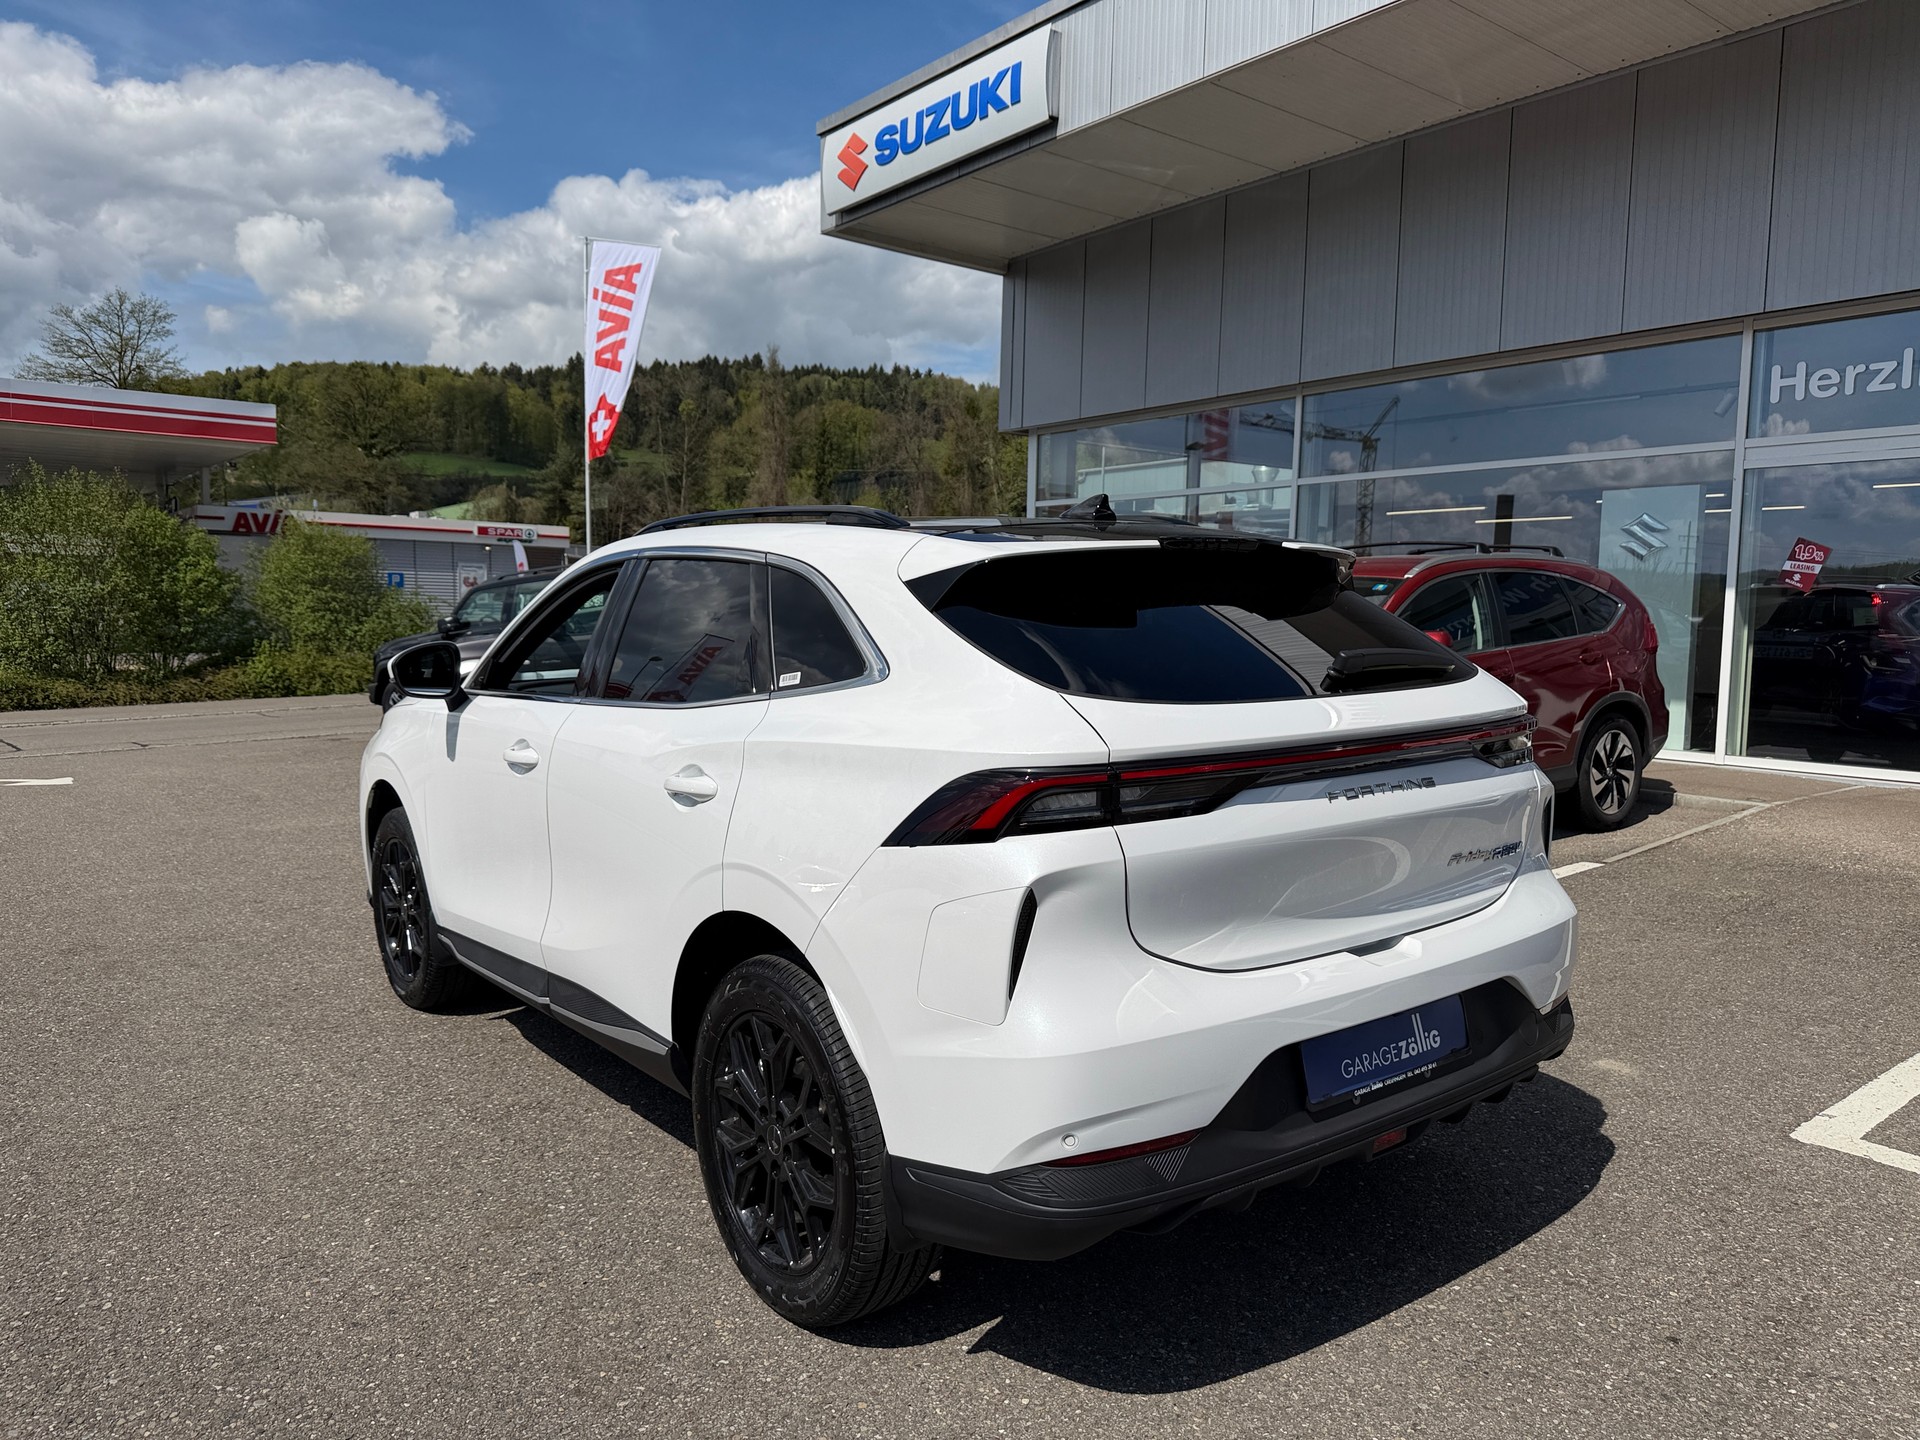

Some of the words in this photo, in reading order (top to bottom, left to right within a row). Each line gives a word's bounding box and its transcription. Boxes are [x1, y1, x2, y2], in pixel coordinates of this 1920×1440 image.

[874, 61, 1022, 167] SUZUKI
[1770, 347, 1920, 404] Herzl
[487, 527, 523, 537] SPAR
[1790, 562, 1815, 572] LEASING
[1325, 776, 1436, 804] FORTHING
